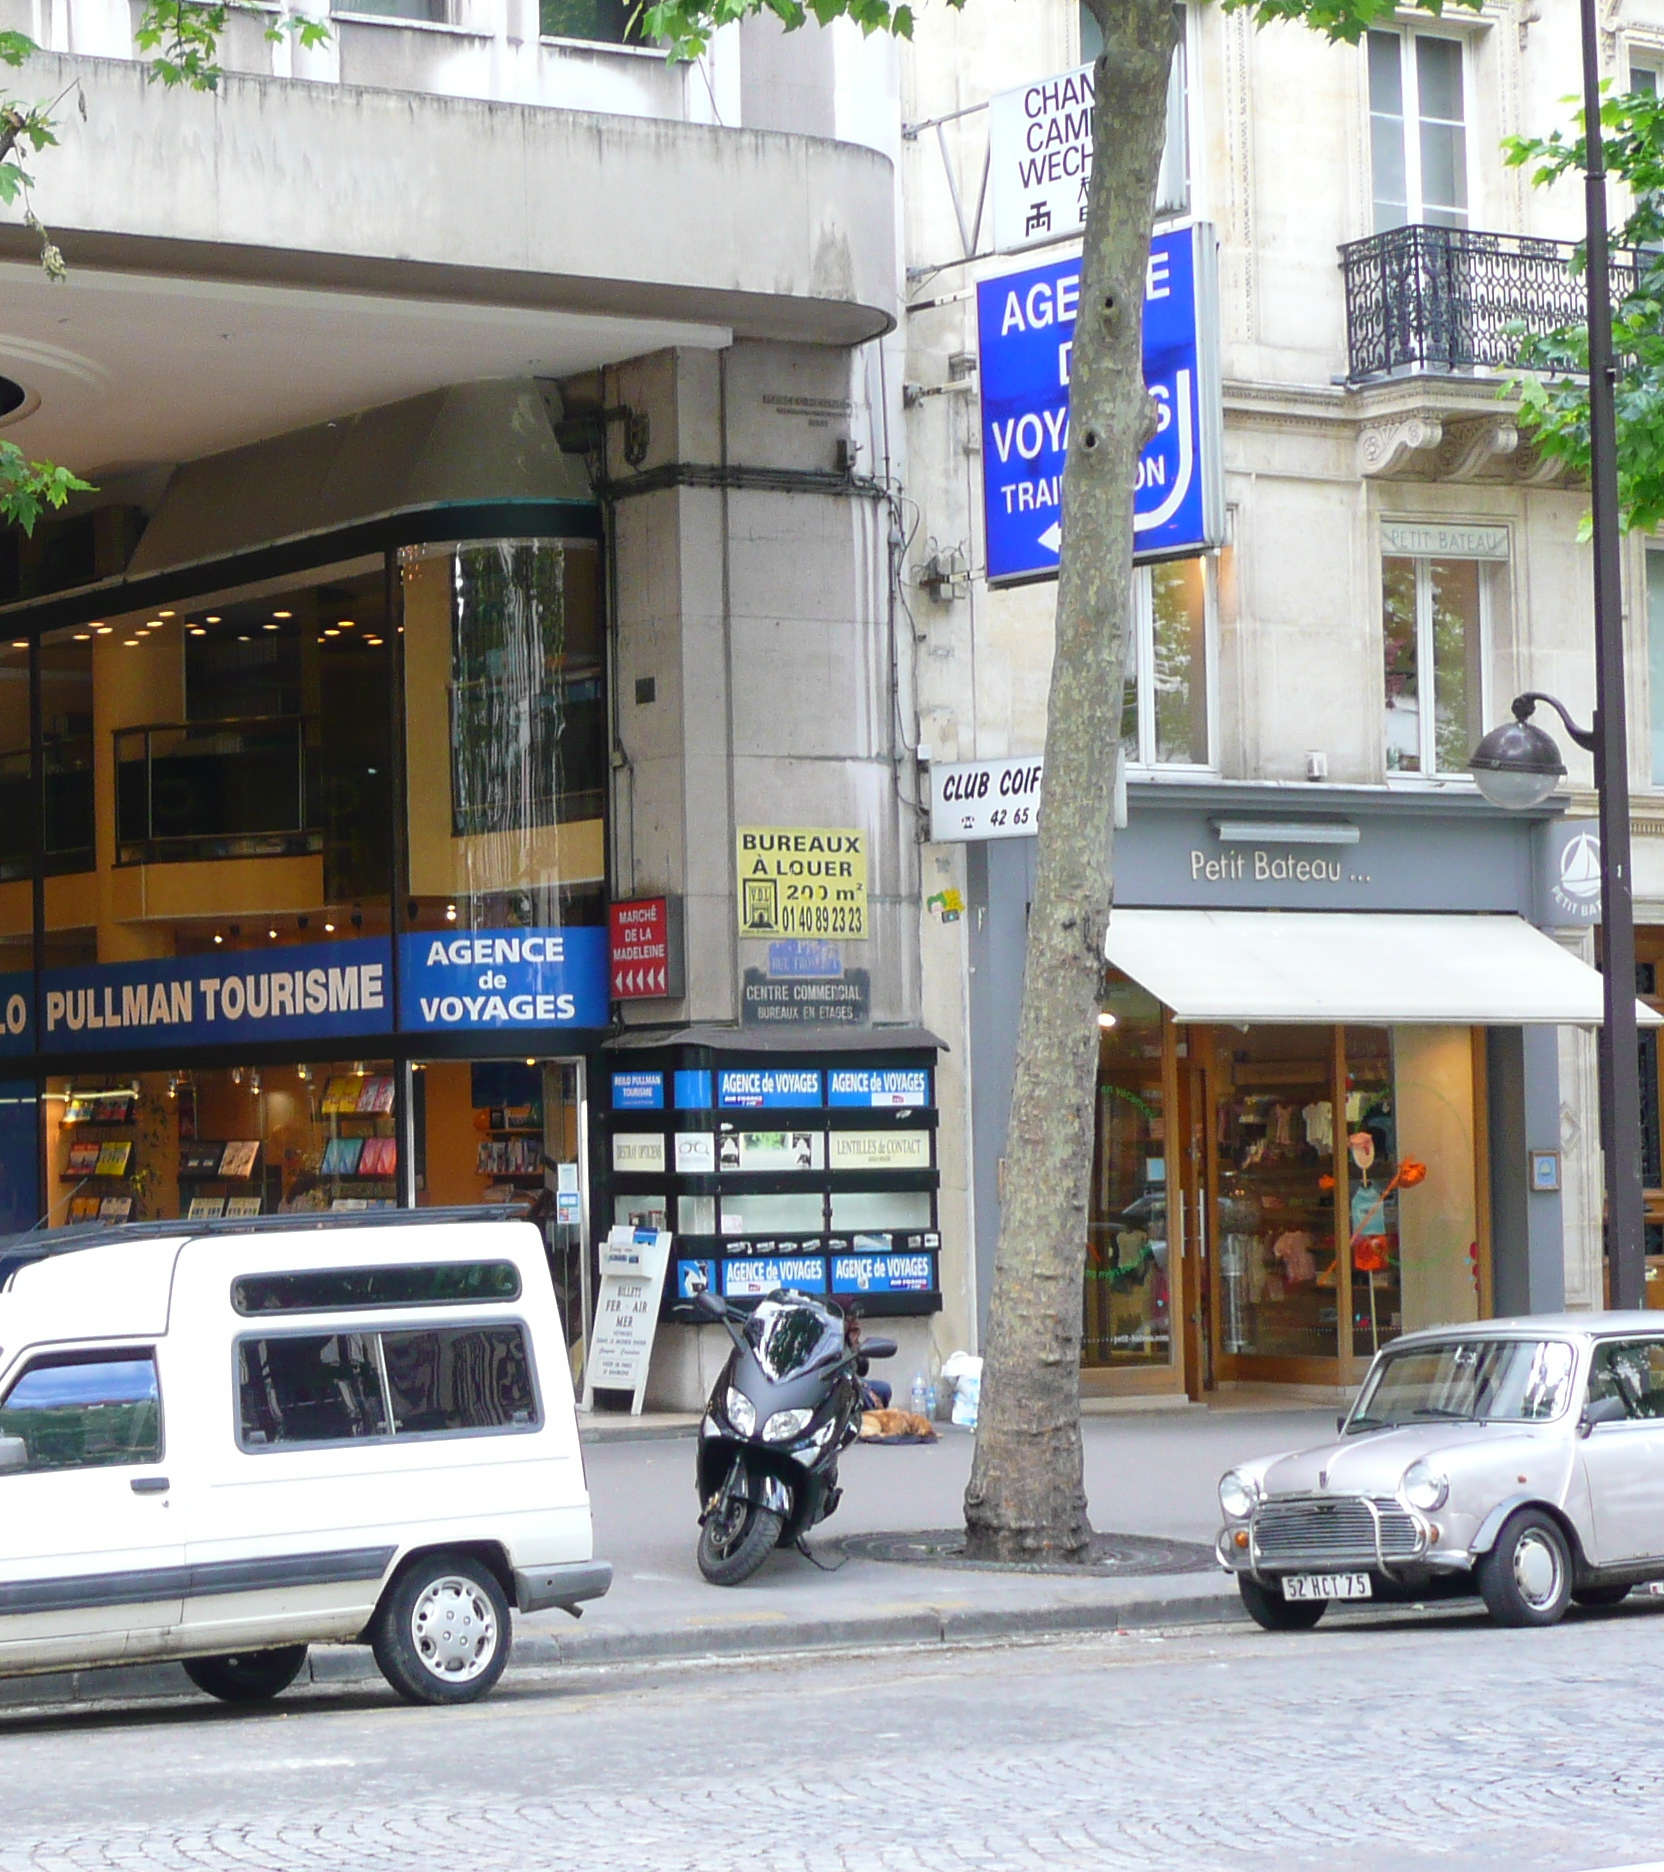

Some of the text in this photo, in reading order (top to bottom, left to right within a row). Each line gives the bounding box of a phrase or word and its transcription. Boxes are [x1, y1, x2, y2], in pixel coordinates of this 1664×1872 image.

[1024, 72, 1096, 119] CHAN
[1018, 143, 1094, 189] WECH
[1392, 530, 1497, 552] PETIT BATEAU
[943, 765, 1042, 802] CLUB COIF
[990, 807, 1030, 827] 42 65
[742, 833, 861, 853] BUREAUX
[752, 853, 853, 878] À LOUER
[1190, 850, 1245, 881] Petit
[1254, 851, 1341, 882] Bateau
[1552, 884, 1578, 915] PETIT
[619, 904, 658, 924] MARCHÉ
[783, 906, 862, 933] 01 40 89 23 23
[625, 926, 652, 942] DE LA
[427, 937, 564, 967] AGENCE
[613, 944, 665, 962] MADELEINE
[478, 970, 507, 990] de
[47, 980, 192, 1031] PULLMAN
[200, 963, 384, 1021] TOURISME
[746, 985, 862, 1001] CENTRE COMMERCIAL
[420, 994, 576, 1023] VOYAGES
[758, 1006, 799, 1019] BUREAUX
[803, 1006, 815, 1018] EN
[632, 1074, 661, 1085] PULLMAN
[723, 1072, 818, 1093] AGENCE de VOYAGES
[832, 1072, 925, 1092] AGENCE de VOYAGES
[623, 1087, 653, 1098] TOURISME
[837, 1139, 877, 1155] LENTILLES
[885, 1139, 921, 1155] CONTACT
[726, 1260, 822, 1281] AGENCE de VOYAGES
[836, 1257, 929, 1279] AGENCE de VOYAGES
[605, 1299, 648, 1313] FER AIR
[615, 1315, 633, 1328] MER
[1287, 1575, 1366, 1597] 52 HCT 75
